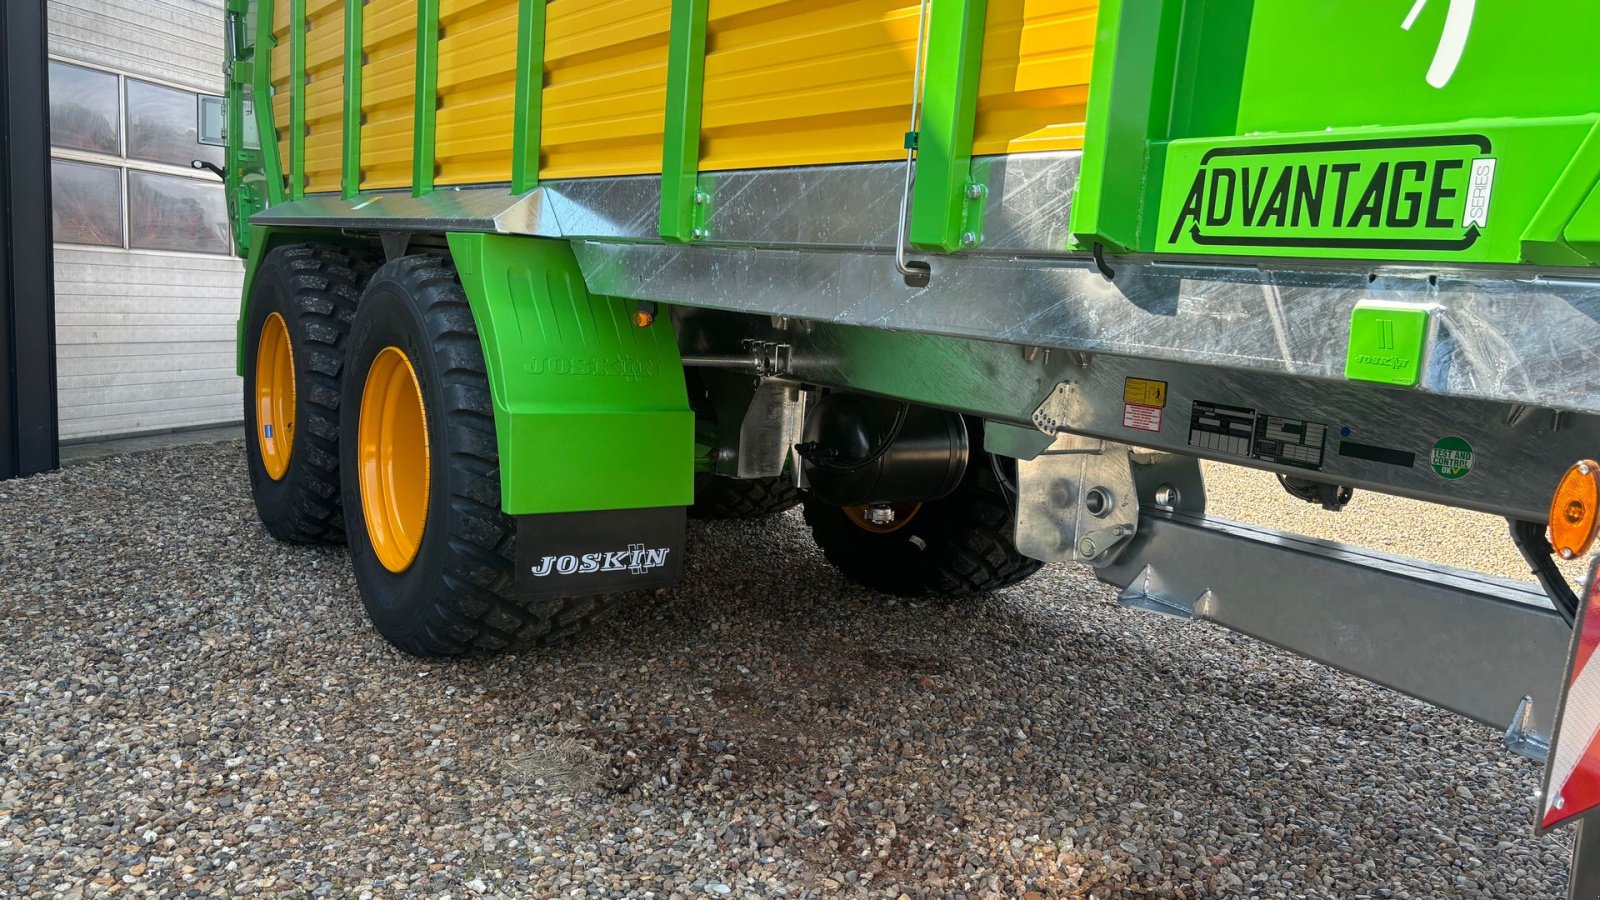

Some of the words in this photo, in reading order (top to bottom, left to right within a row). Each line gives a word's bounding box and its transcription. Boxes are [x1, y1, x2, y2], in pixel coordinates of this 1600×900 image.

[1168, 159, 1464, 244] ADVANTAGE
[1469, 164, 1490, 219] SERIES
[1432, 456, 1469, 469] CONTROL
[1433, 448, 1452, 459] TEST
[1454, 452, 1472, 461] AND
[1441, 466, 1451, 474] OK
[531, 544, 670, 577] JOSKIN
